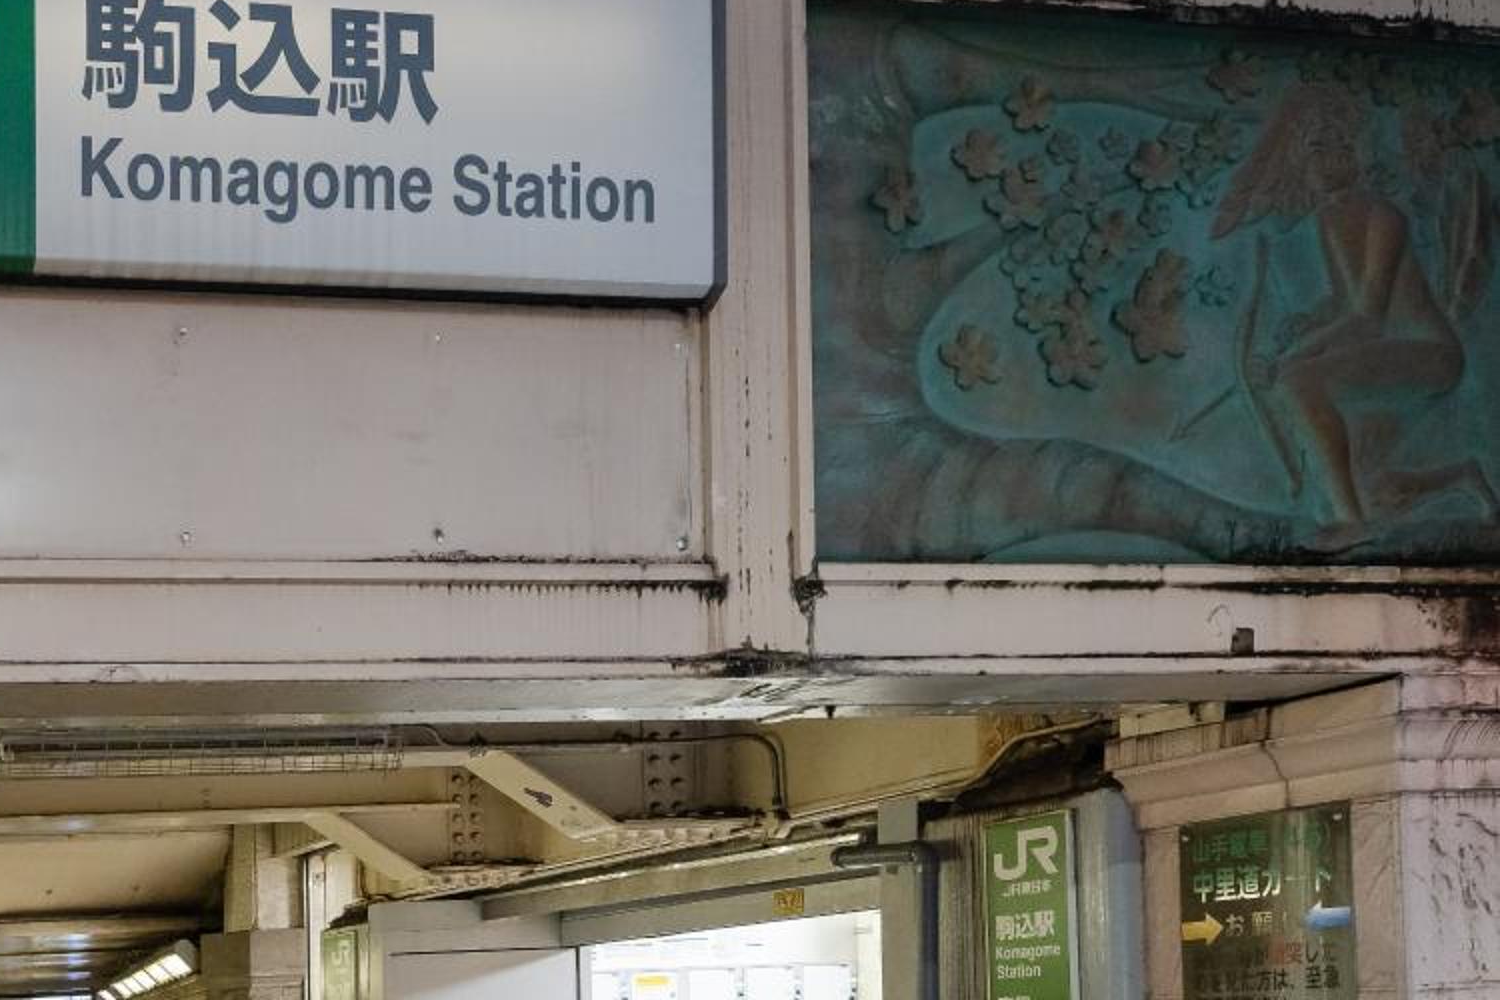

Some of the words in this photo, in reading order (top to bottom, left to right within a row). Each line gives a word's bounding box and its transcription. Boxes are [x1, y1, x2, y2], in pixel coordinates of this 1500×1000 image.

[79, 135, 434, 224] Komagome
[453, 153, 656, 224] Station
[993, 825, 1060, 881] JR
[995, 910, 1056, 941] 駒込駅
[995, 944, 1061, 962] Komagome
[997, 962, 1041, 979] Station
